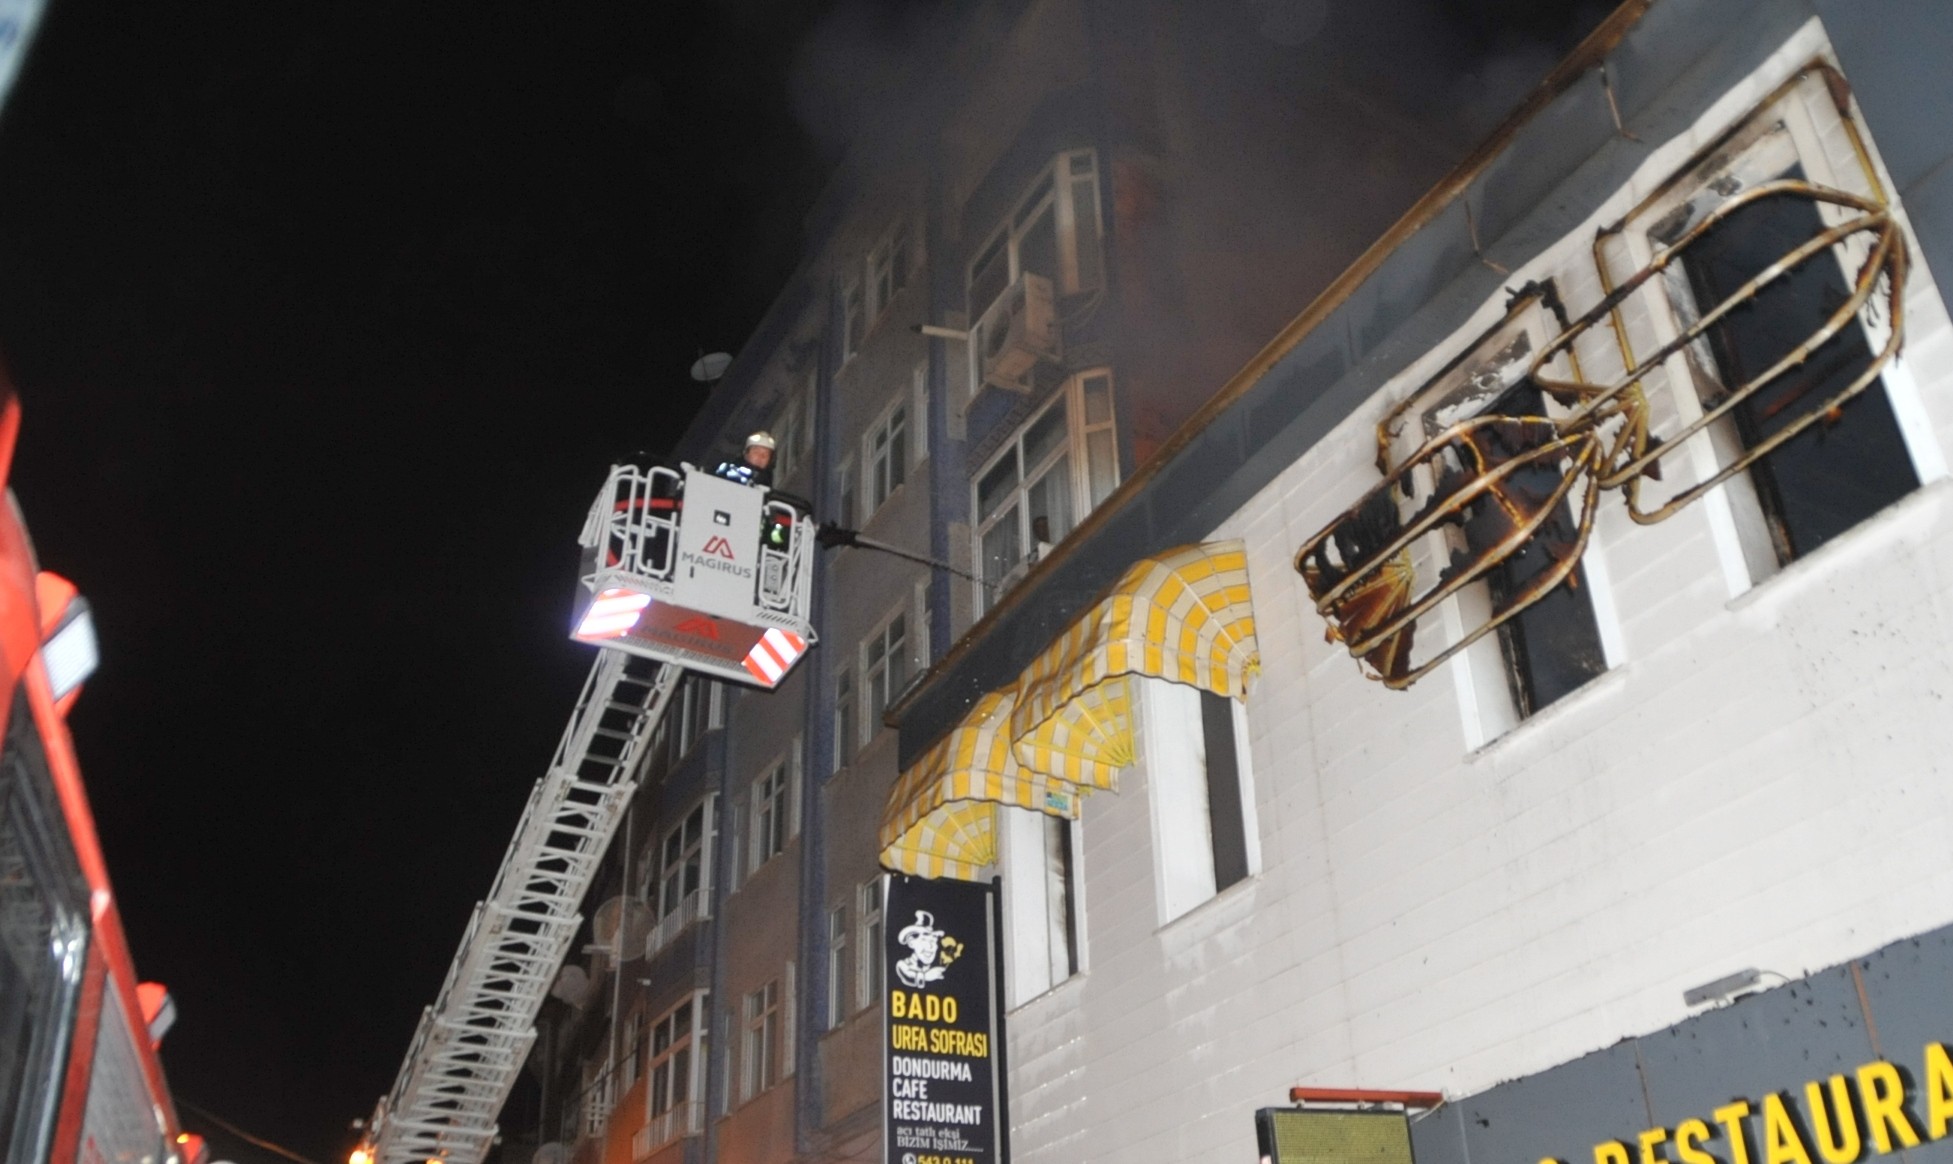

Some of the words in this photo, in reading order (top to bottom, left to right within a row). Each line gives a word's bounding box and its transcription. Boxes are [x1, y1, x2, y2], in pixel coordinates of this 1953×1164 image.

[682, 551, 752, 579] MAGIRUS
[892, 990, 957, 1024] BADO
[893, 1024, 928, 1052] URFA
[930, 1028, 988, 1058] SOFRASI
[893, 1055, 972, 1082] DONDURMA
[892, 1077, 928, 1100] CAFE
[893, 1099, 982, 1125] RESTAURANT
